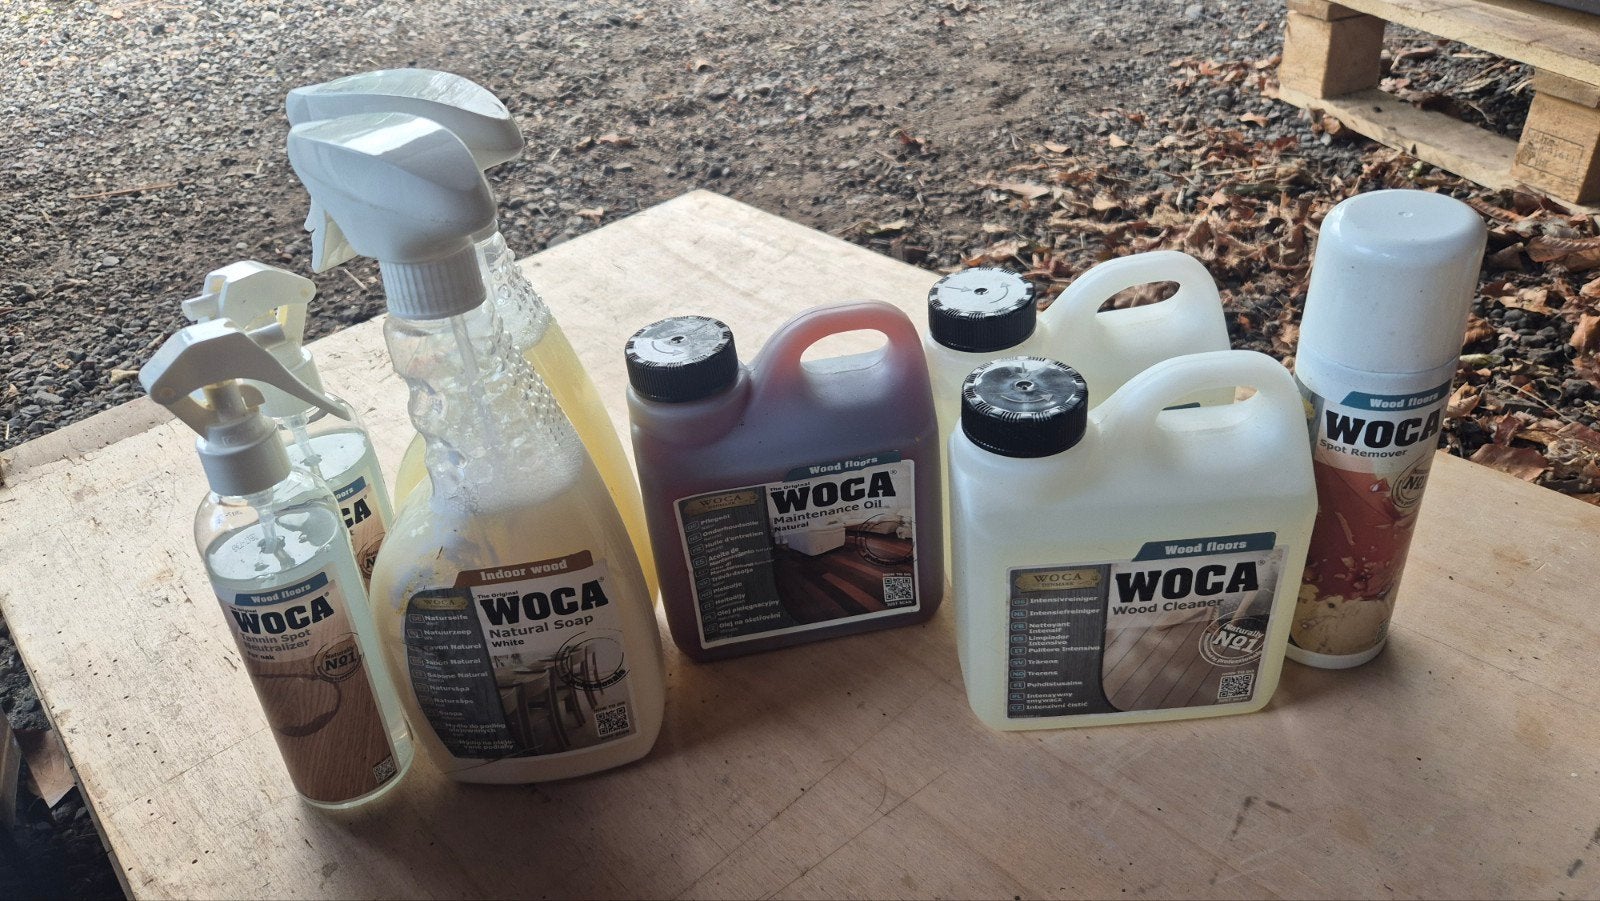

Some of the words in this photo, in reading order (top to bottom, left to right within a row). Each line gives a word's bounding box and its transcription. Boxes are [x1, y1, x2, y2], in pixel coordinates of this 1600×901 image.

[1370, 398, 1404, 408] Wood
[1408, 392, 1438, 406] floors
[1326, 408, 1441, 448] WOCA
[1320, 439, 1347, 454] Spot
[1351, 448, 1408, 458] Remover
[809, 462, 841, 474] Wood
[845, 457, 878, 468] floors
[771, 471, 896, 514] WOCA
[784, 482, 810, 490] Original
[700, 494, 741, 506] WOCA
[774, 505, 860, 524] Maintenance
[864, 500, 882, 509] Oil
[775, 522, 809, 532] Natural
[1165, 544, 1202, 555] Wood
[1207, 541, 1247, 552] floors
[480, 569, 526, 581] Indoor
[530, 560, 568, 574] wood
[1034, 573, 1081, 582] WOCA
[1115, 562, 1258, 603] WOCA
[250, 592, 279, 603] Wood
[282, 583, 311, 598] floors
[480, 580, 608, 626] WOCA
[1113, 604, 1157, 615] Wood
[1163, 599, 1224, 611] Cleaner
[231, 596, 334, 634] WOCA
[489, 622, 549, 639] Natural
[554, 615, 594, 630] Soap
[1224, 624, 1264, 638] Naturally
[242, 633, 278, 644] Tannin
[281, 629, 311, 643] Spot
[492, 639, 524, 648] White
[244, 639, 310, 652] Neutralizer
